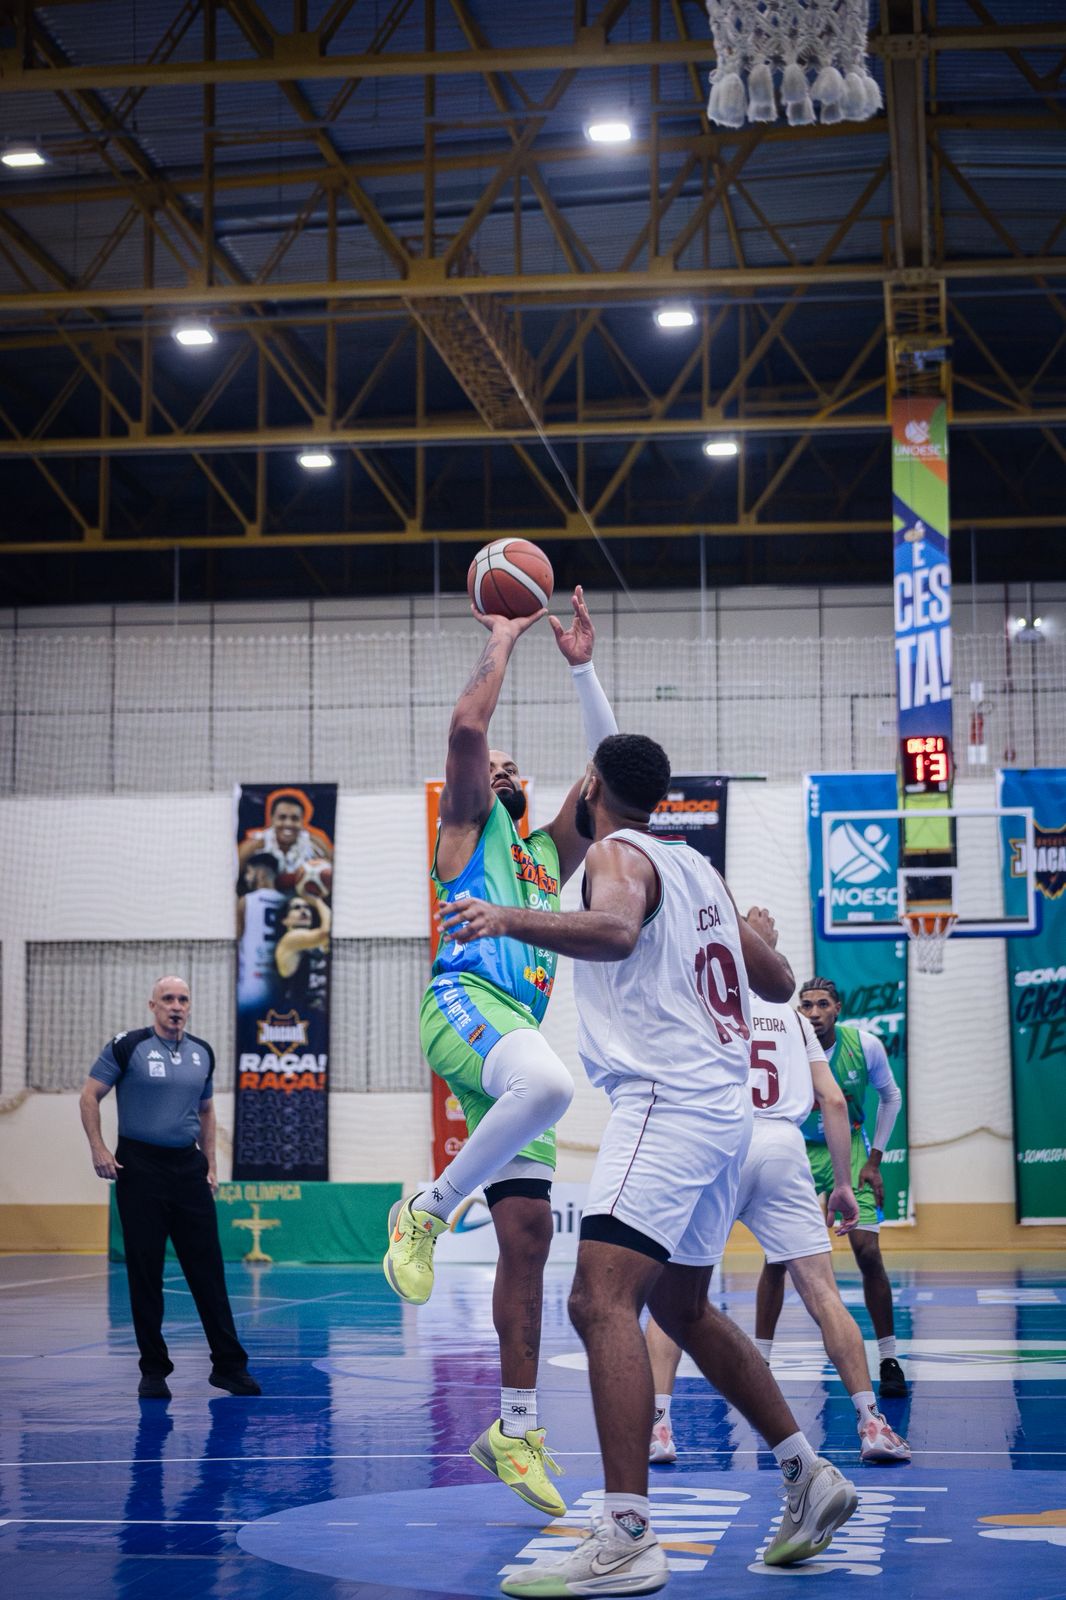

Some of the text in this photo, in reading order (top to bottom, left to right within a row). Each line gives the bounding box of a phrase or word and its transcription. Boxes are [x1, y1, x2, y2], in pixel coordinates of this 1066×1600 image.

[894, 564, 951, 632] CES
[896, 627, 951, 711] TA!
[819, 887, 899, 906] NOESC
[753, 1017, 787, 1034] PEDRA
[239, 1053, 327, 1078] RAÇA!
[240, 1072, 326, 1095] RAÇA!
